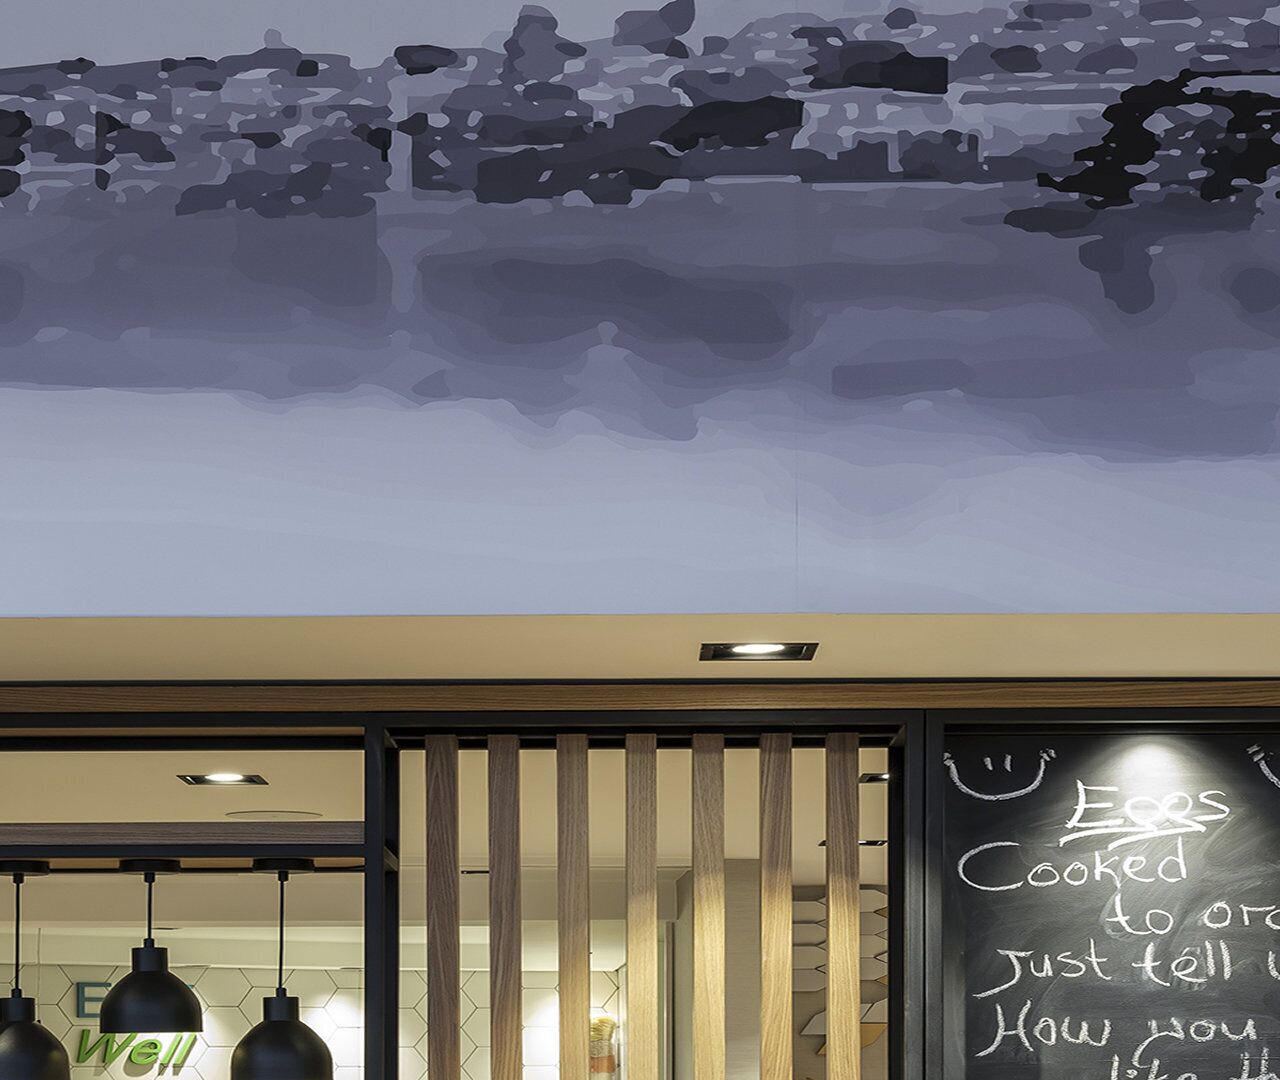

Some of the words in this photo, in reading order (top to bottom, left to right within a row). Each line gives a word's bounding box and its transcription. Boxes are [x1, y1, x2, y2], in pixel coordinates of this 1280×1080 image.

[957, 836, 1188, 891] Cooked
[1106, 892, 1174, 935] to
[1132, 940, 1232, 986] tell
[76, 1029, 198, 1065] Well
[975, 1000, 1112, 1057] How
[1131, 1018, 1258, 1068] you
